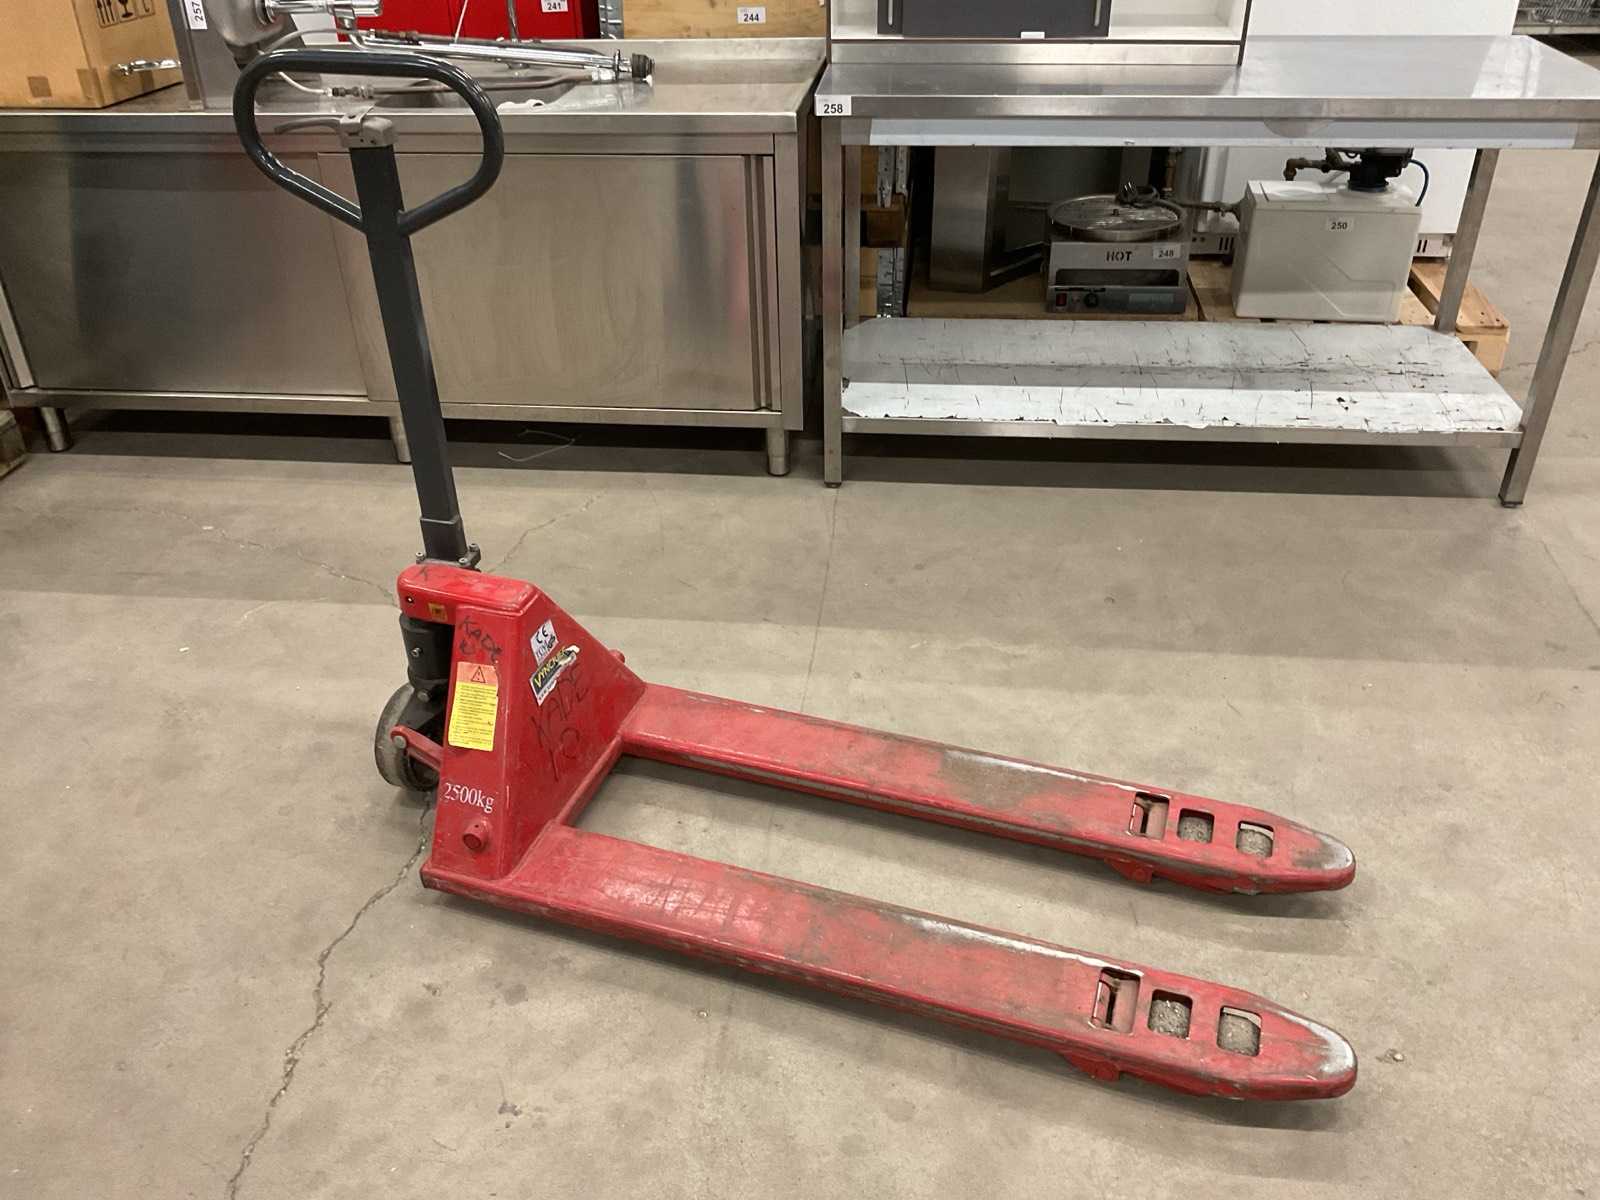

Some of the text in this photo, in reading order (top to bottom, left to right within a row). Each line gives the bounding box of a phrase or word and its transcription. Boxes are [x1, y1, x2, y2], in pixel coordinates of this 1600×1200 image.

[192, 1, 204, 21] 257
[547, 2, 562, 10] 241
[743, 13, 760, 22] 244
[823, 103, 844, 114] 258
[1331, 221, 1348, 230] 250
[1106, 250, 1133, 261] HOT
[444, 782, 495, 814] 2500kg
